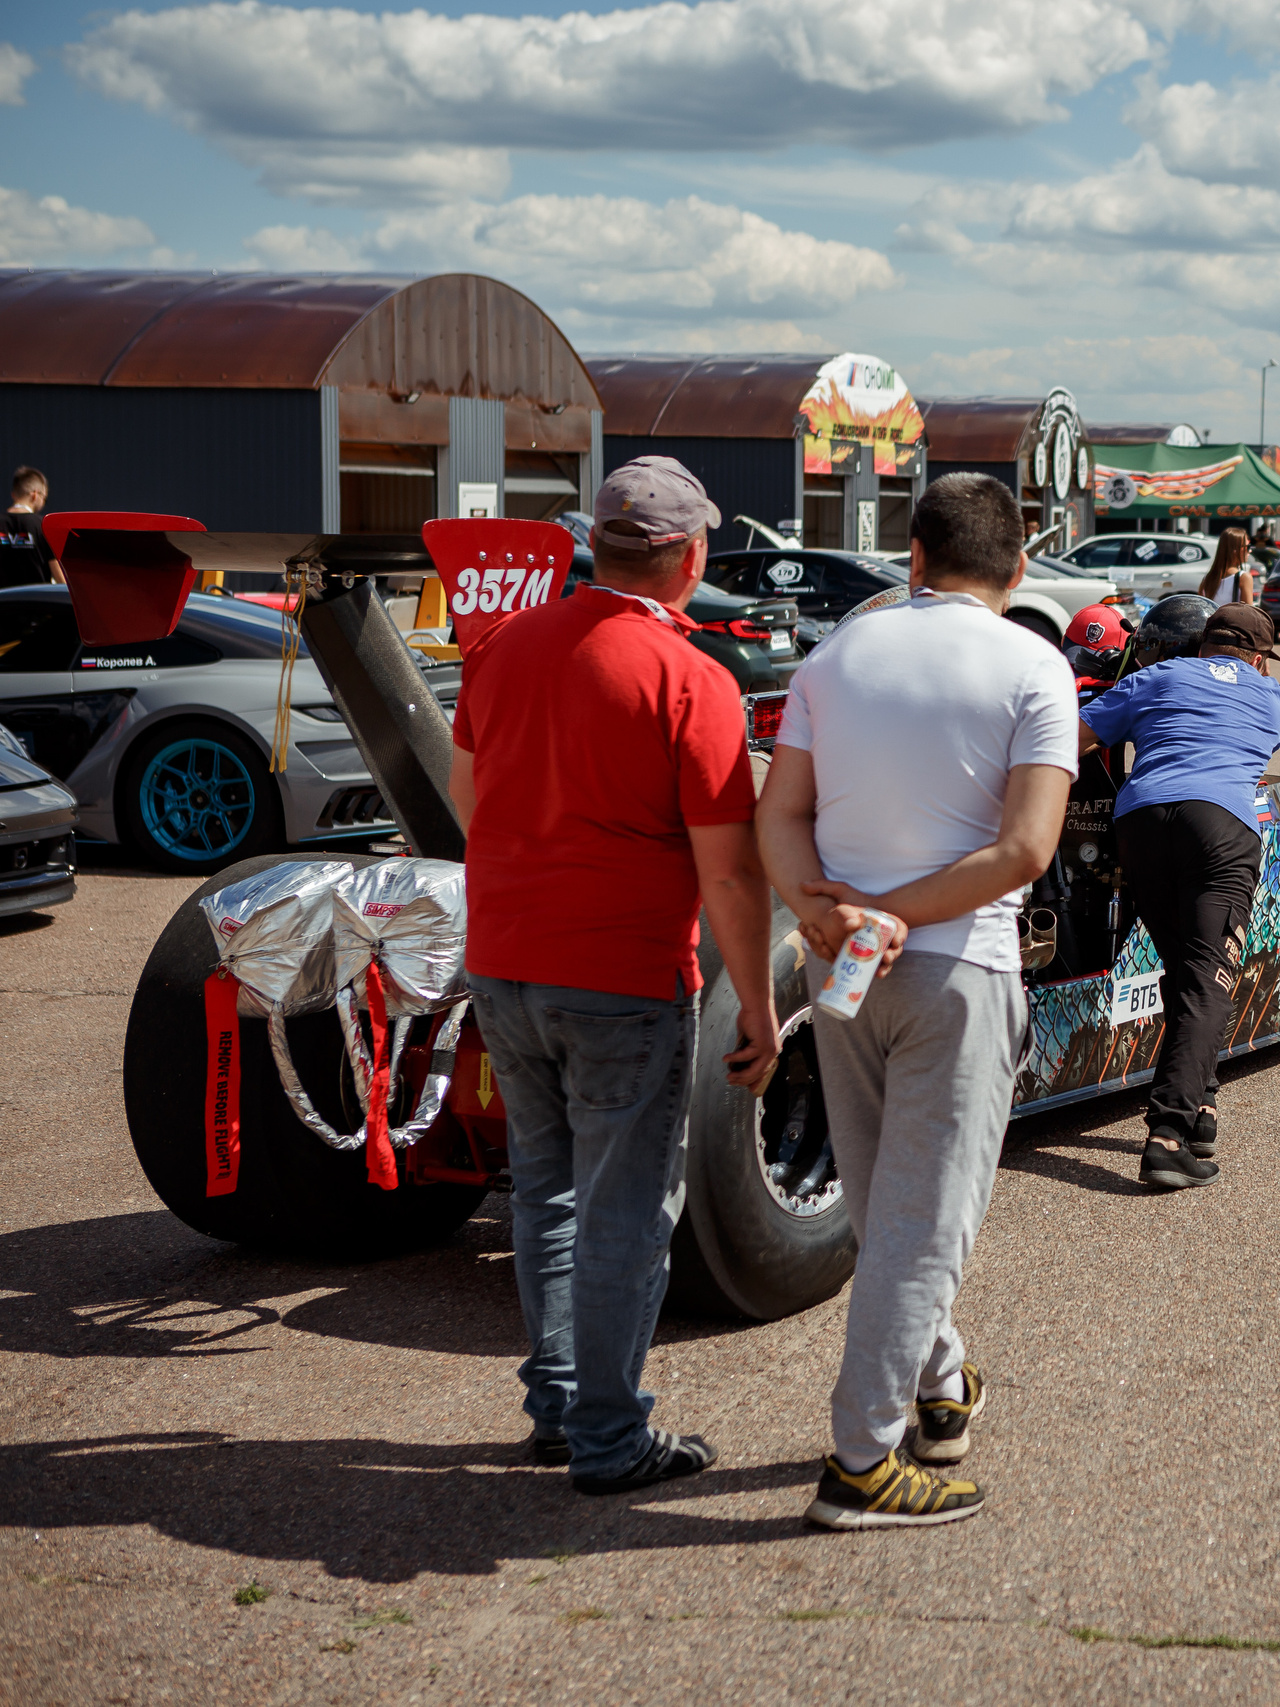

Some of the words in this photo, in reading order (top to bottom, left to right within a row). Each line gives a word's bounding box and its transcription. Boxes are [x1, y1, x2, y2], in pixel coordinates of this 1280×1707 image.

[1168, 505, 1213, 517] OWL
[452, 568, 554, 615] 357M
[97, 657, 143, 669] Королев
[145, 655, 157, 666] А.
[1067, 819, 1108, 832] Chassis
[366, 904, 404, 916] SIMPSO
[1130, 983, 1158, 1013] ВТБ
[217, 1031, 232, 1079] REMOVE
[214, 1081, 228, 1126] BEFORE
[215, 1129, 231, 1170] FLIGHT
